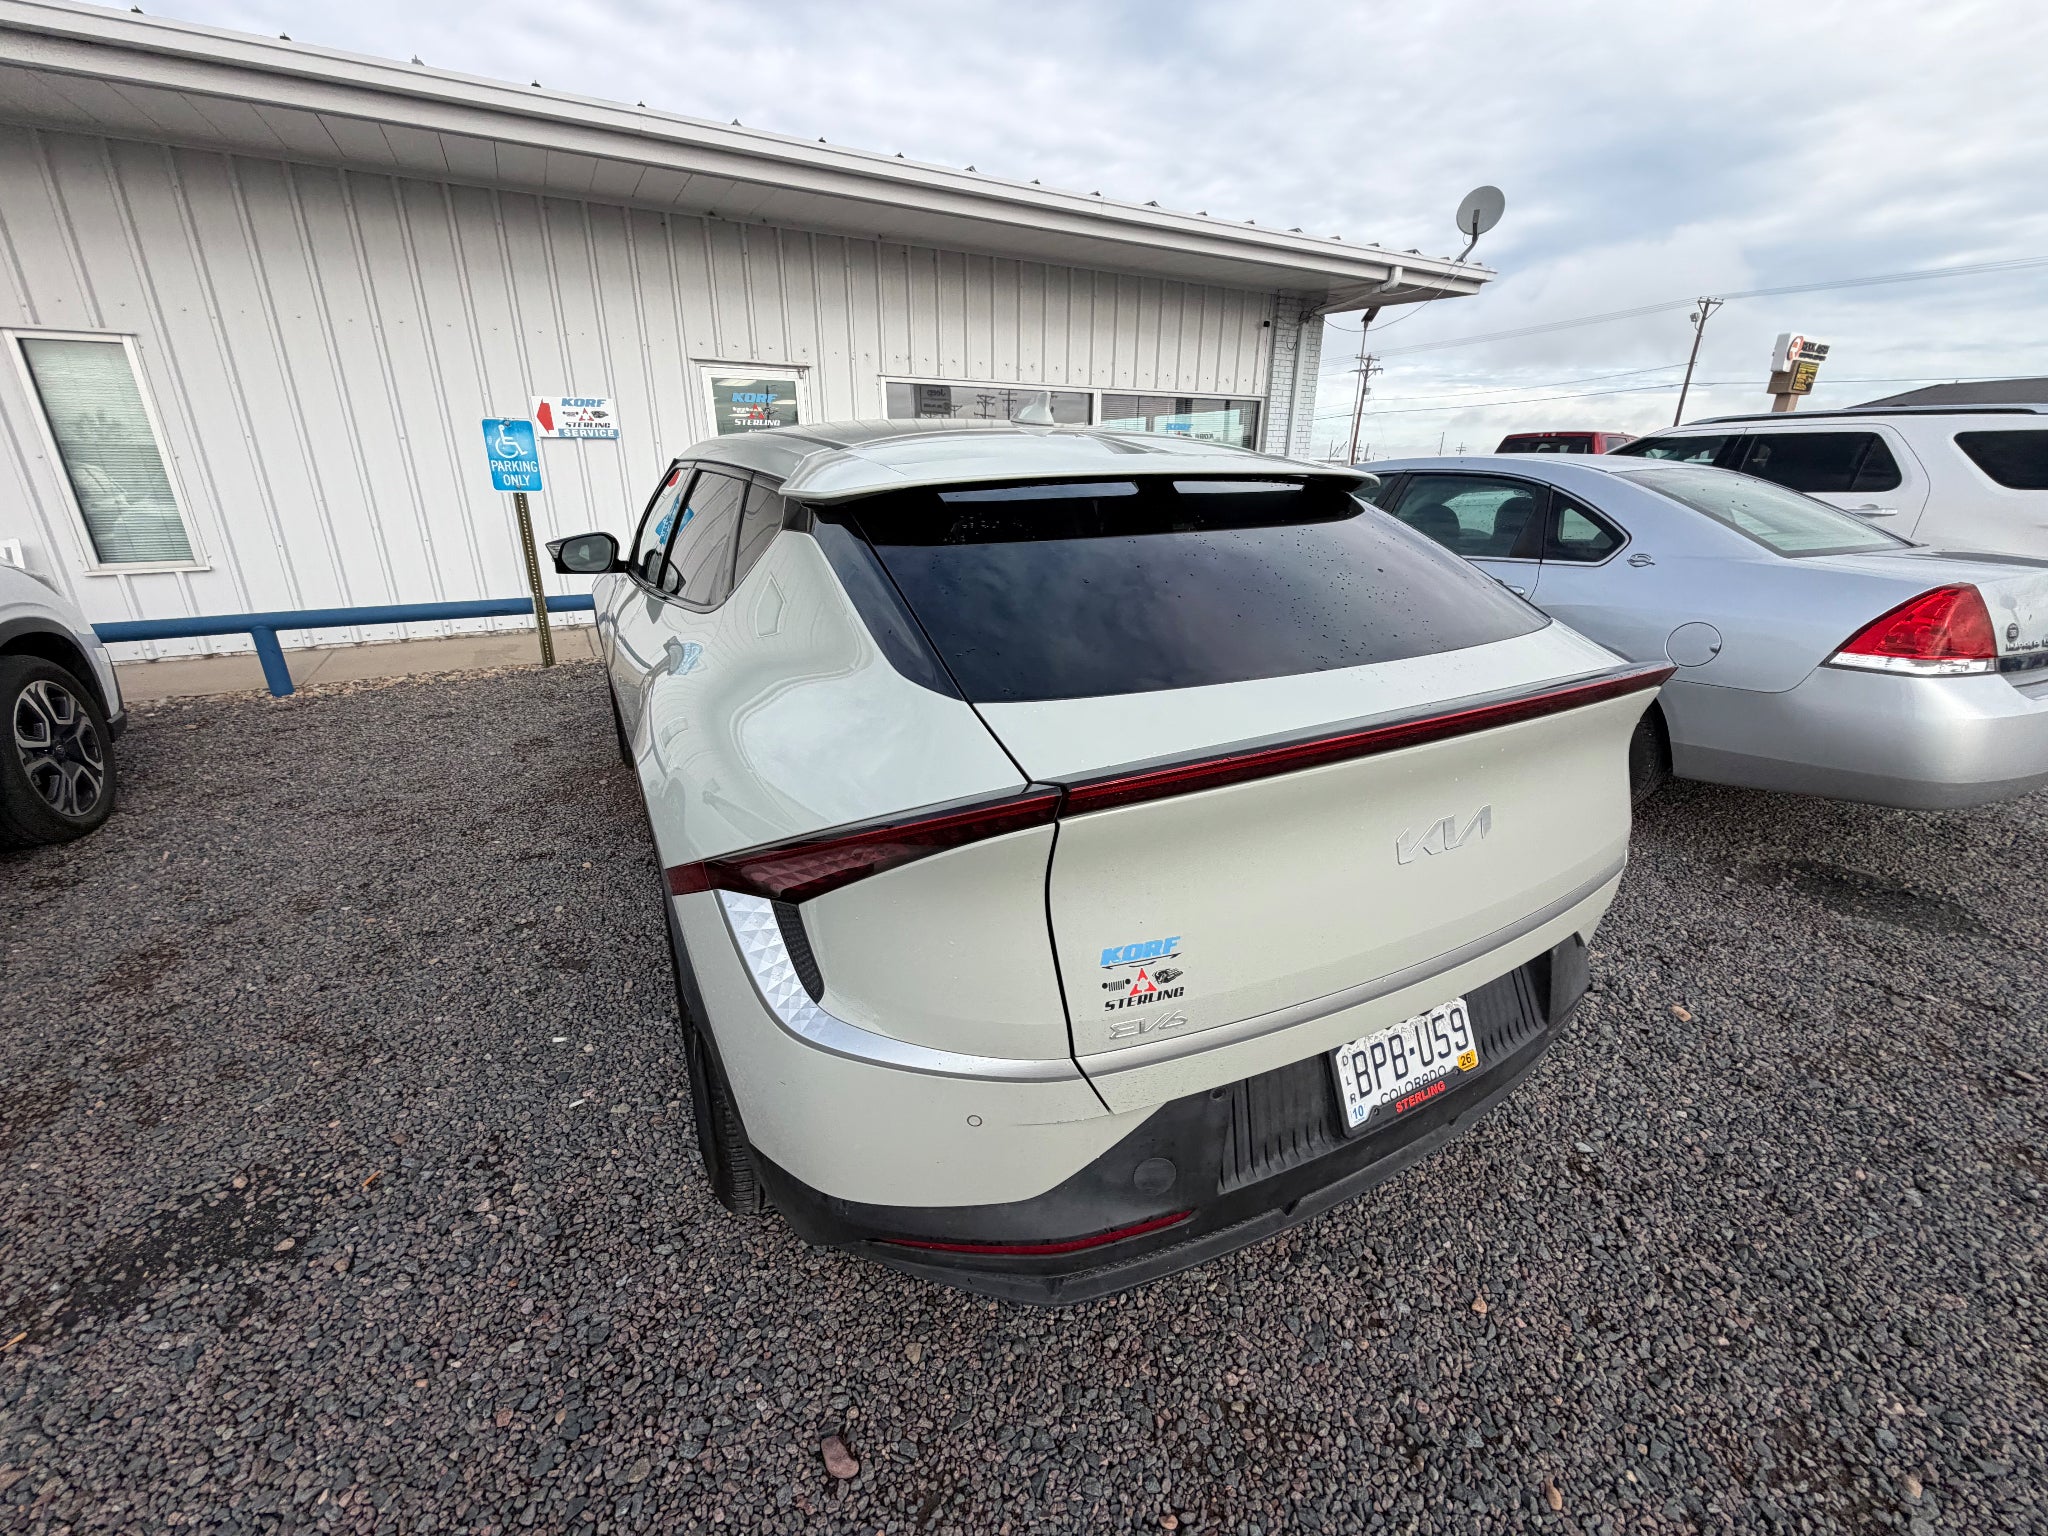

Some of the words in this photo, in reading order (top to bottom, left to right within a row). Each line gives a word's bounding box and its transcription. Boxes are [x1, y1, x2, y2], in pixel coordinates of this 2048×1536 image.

[561, 398, 607, 407] KORF
[732, 391, 778, 404] KORF
[735, 418, 781, 427] STERLING
[563, 429, 615, 437] SERVICE
[490, 459, 538, 473] PARKING
[502, 474, 530, 486] ONLY
[1100, 935, 1181, 966] KORF
[1104, 986, 1185, 1012] STERLING
[1109, 1009, 1188, 1040] EV6
[1460, 1053, 1472, 1067] 26
[1380, 1064, 1447, 1106] COLORADO
[1395, 1080, 1447, 1114] STERLING
[1352, 1104, 1364, 1120] 10
